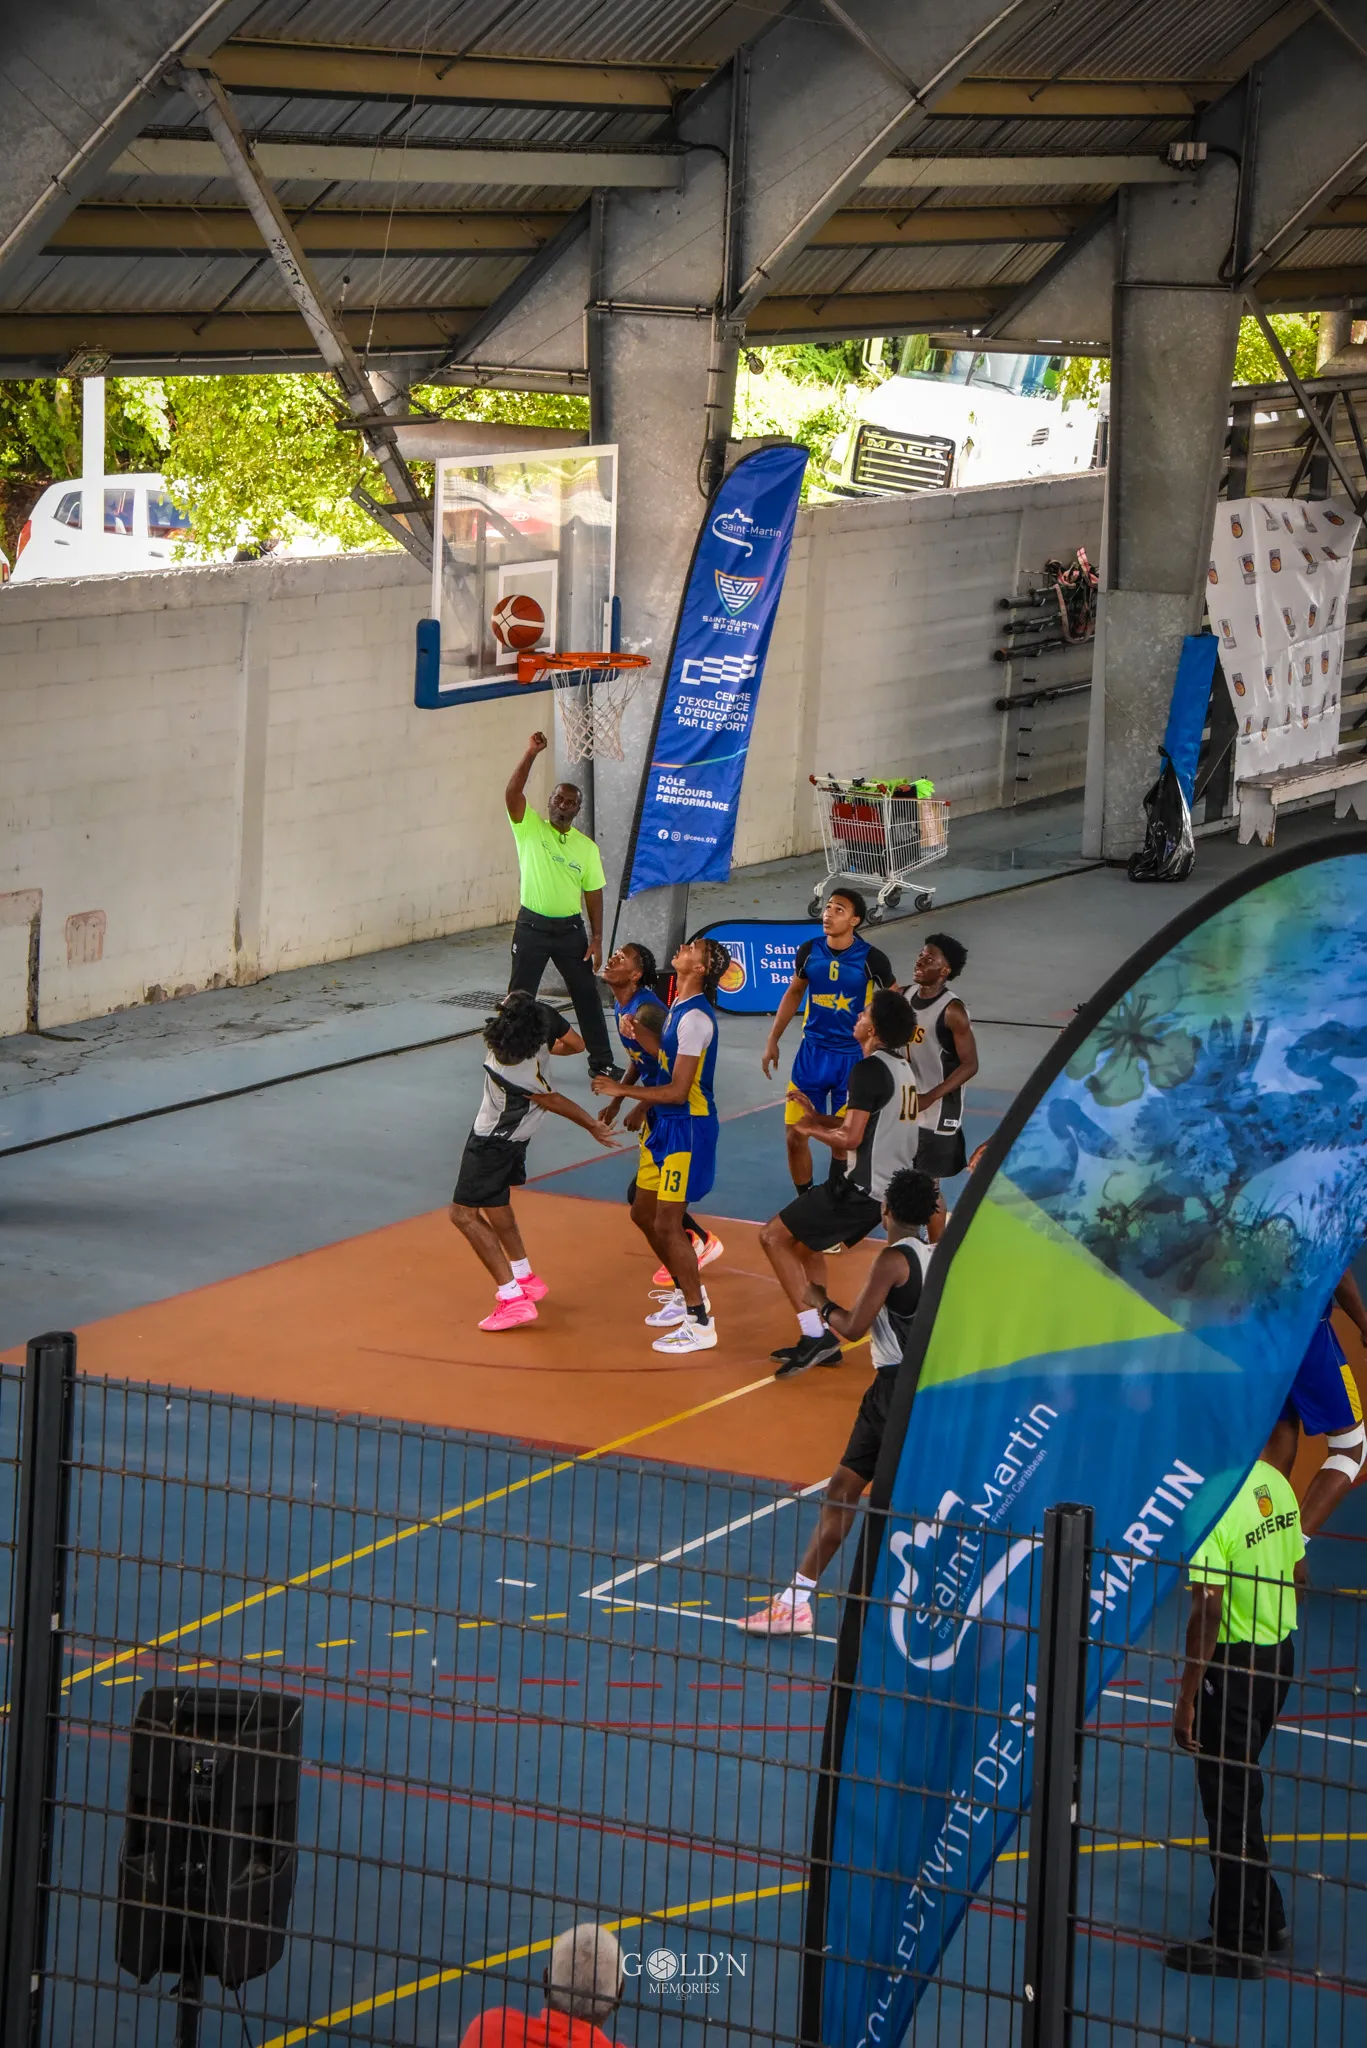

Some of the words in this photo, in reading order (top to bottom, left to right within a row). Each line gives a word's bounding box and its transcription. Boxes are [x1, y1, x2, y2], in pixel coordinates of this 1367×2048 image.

[867, 437, 944, 459] MACK
[721, 520, 782, 538] Saint-Martin
[702, 615, 759, 631] SAINT-MARTIN
[712, 622, 748, 635] SPORT
[715, 691, 751, 702] CENTRE
[674, 705, 682, 715] &
[678, 716, 699, 728] PAR
[701, 720, 714, 731] LE
[659, 775, 686, 787] PÔLE
[657, 785, 713, 799] PARCOURS
[655, 794, 729, 811] PERFORMANCE
[829, 960, 840, 982] 6
[899, 1085, 918, 1121] 10
[664, 1169, 682, 1193] 13
[990, 1493, 1016, 1524] French
[1011, 1449, 1047, 1494] Caribbean
[914, 1403, 1059, 1631] Saint-Martin
[974, 1729, 1027, 1792] DE
